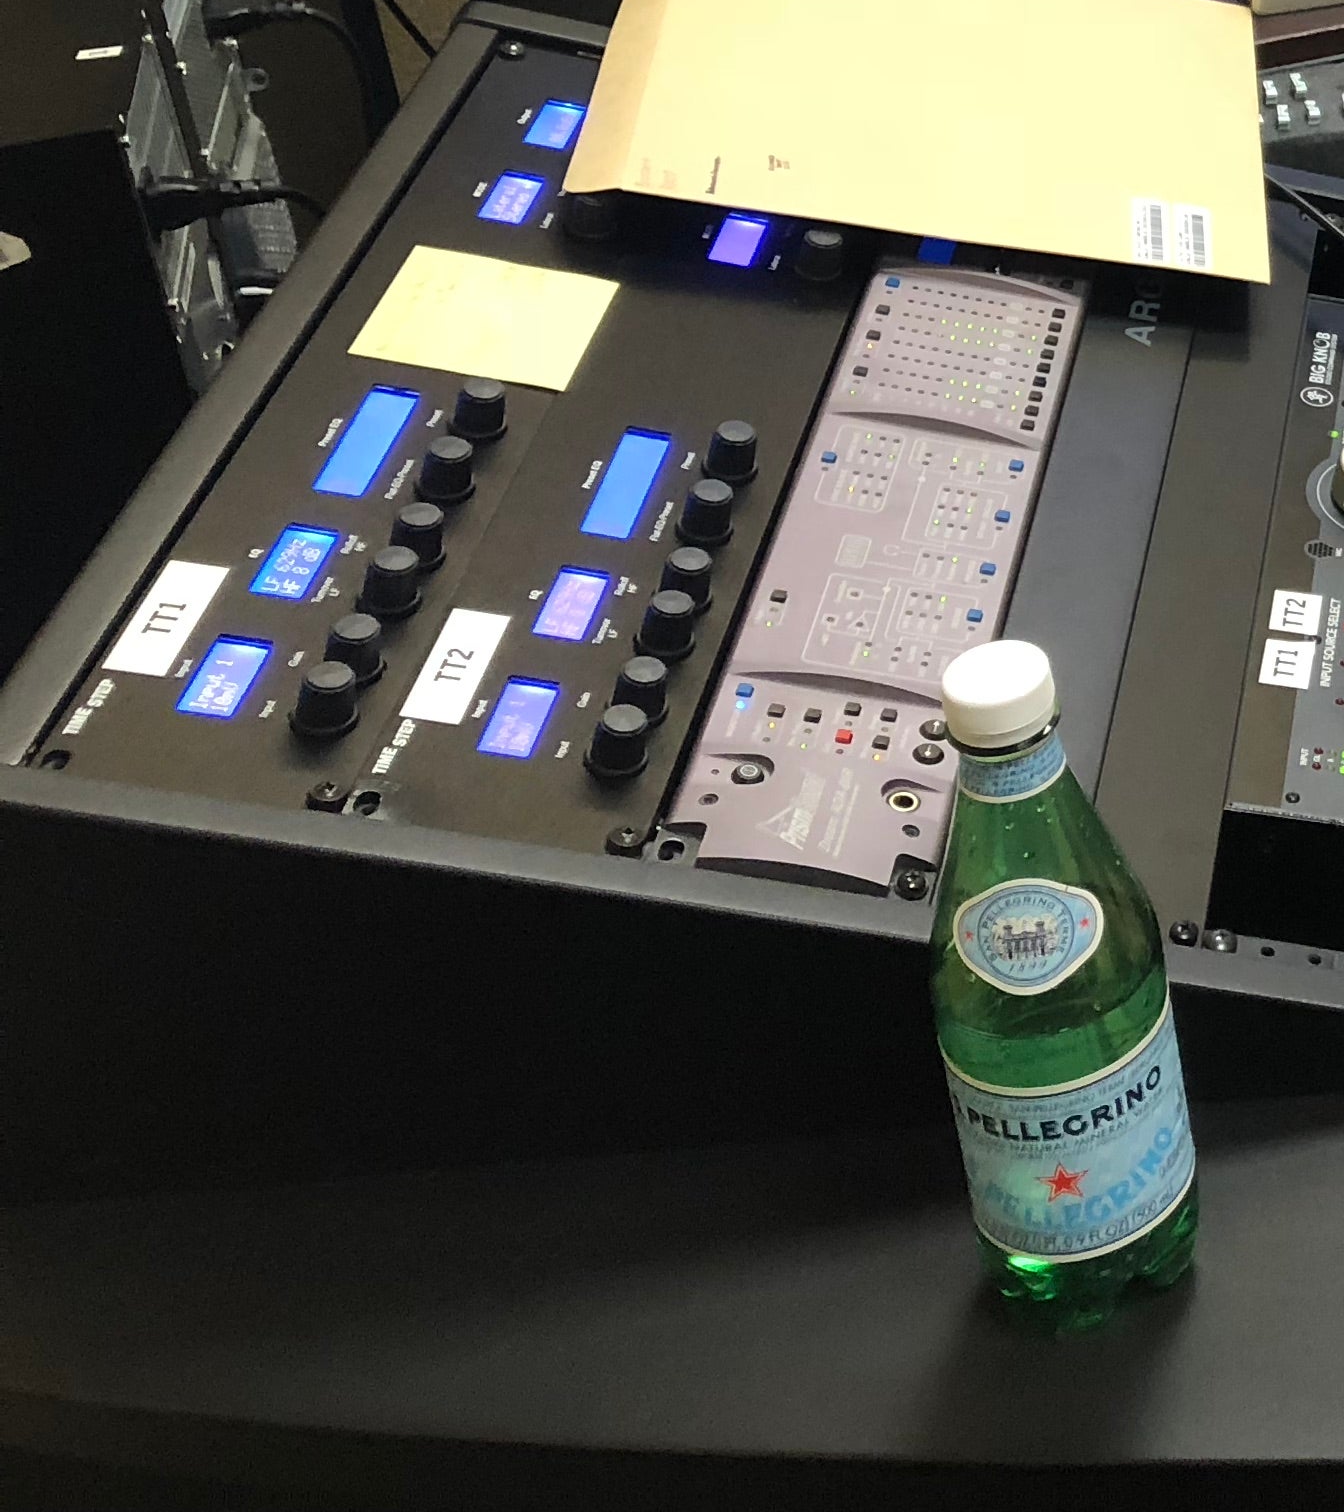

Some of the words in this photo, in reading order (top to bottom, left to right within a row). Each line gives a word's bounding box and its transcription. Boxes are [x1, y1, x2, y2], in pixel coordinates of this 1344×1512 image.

[1312, 331, 1332, 365] KNOB
[1308, 363, 1326, 384] BIG
[261, 575, 280, 592] LF
[280, 578, 301, 595] HF
[141, 603, 187, 634] TT1
[1282, 598, 1307, 627] TT2
[1327, 597, 1342, 629] SELECT
[1322, 628, 1338, 662] SOURCE
[434, 648, 475, 681] TT2
[1273, 649, 1299, 677] TT1
[1319, 661, 1333, 688] INPUT
[61, 706, 94, 735] TIME
[86, 678, 116, 708] STEP
[188, 673, 226, 709] Input
[371, 745, 398, 774] TIME
[392, 718, 417, 748] STEP
[981, 896, 1056, 930] PELLEGRINO
[1056, 910, 1070, 954] TERME
[982, 938, 998, 963] SAN
